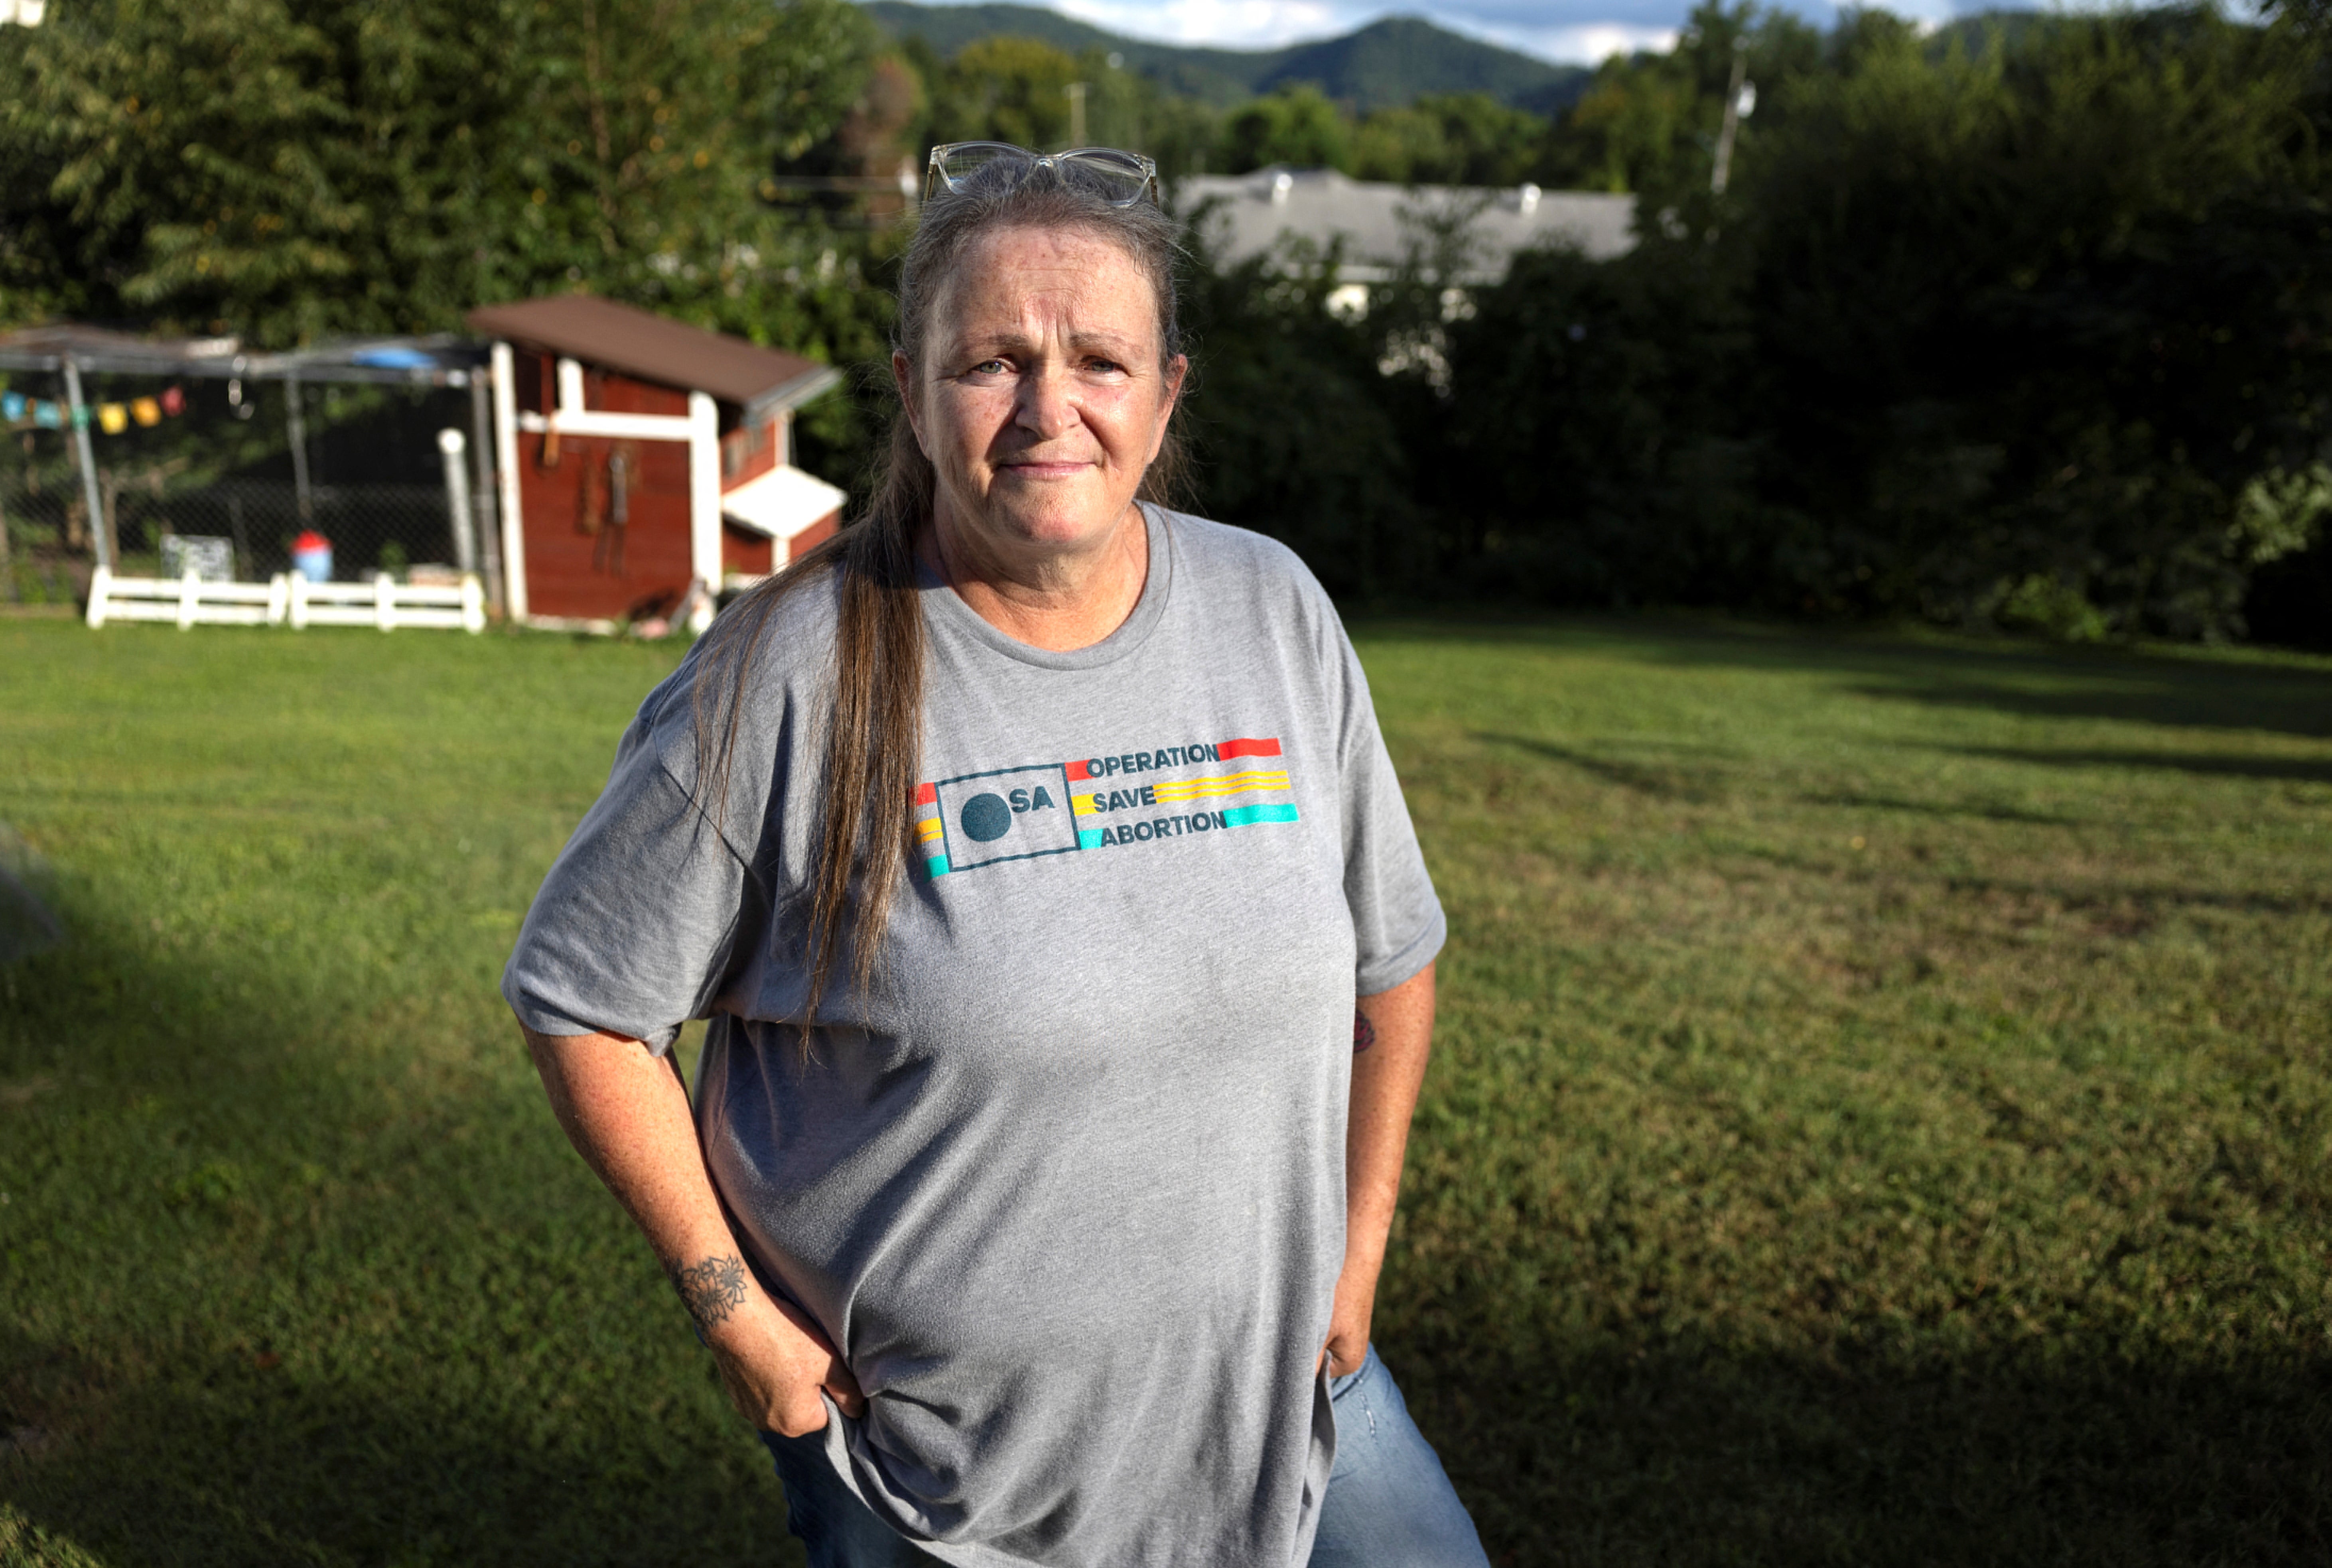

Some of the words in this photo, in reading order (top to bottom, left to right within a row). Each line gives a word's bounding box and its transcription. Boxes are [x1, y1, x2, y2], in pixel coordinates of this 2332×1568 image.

[1086, 744, 1220, 778] OPERATION
[1093, 785, 1156, 813] SAVE
[1101, 811, 1228, 847] ABORTION
